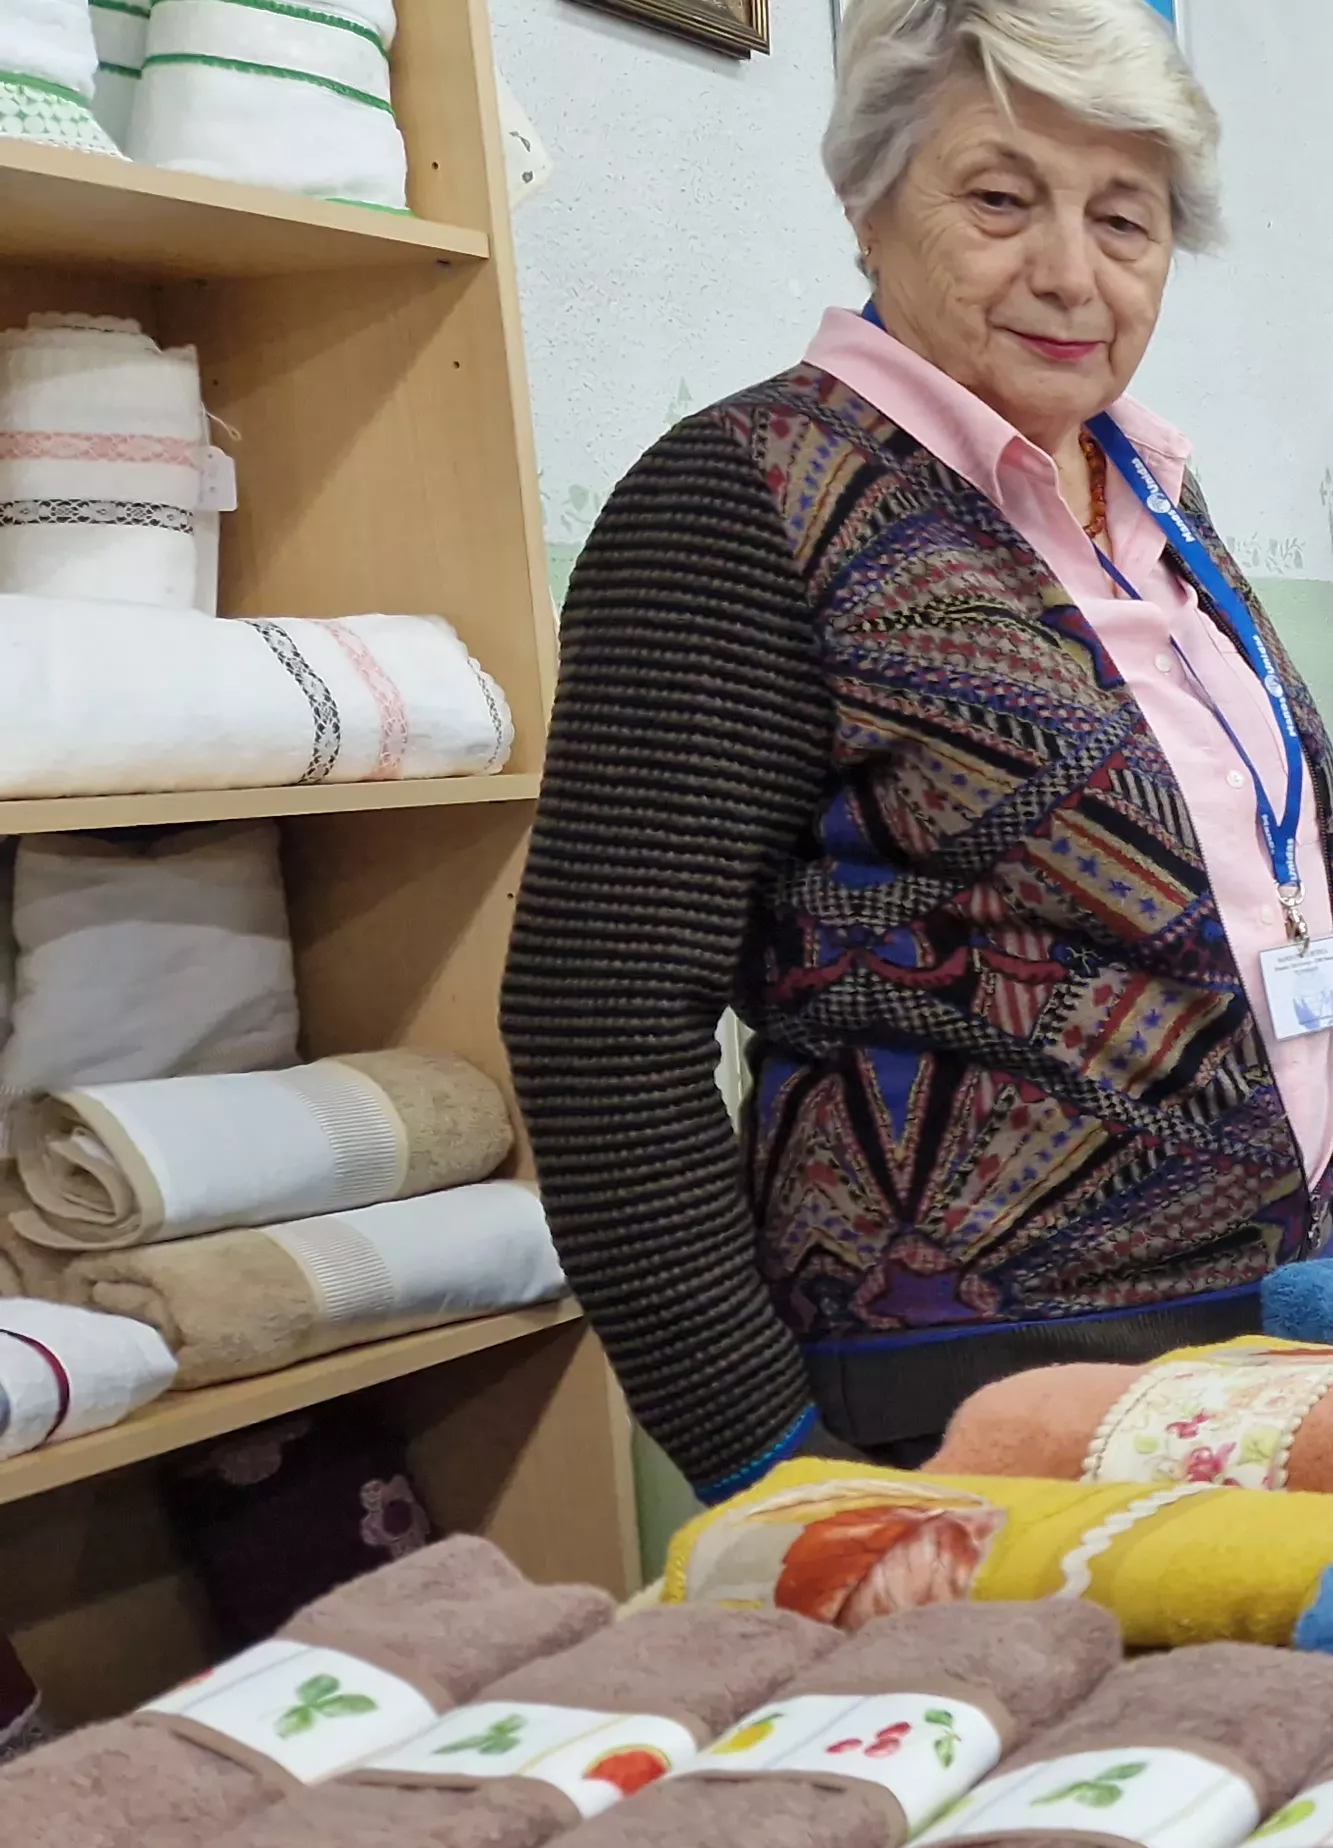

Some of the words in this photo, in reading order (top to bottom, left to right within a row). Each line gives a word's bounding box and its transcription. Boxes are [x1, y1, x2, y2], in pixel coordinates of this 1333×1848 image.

[1131, 457, 1160, 494] Unidas
[1166, 509, 1197, 544] Manos
[1252, 634, 1275, 675] Unidas
[1279, 696, 1297, 737] Manos
[1285, 837, 1298, 881] Unidas
